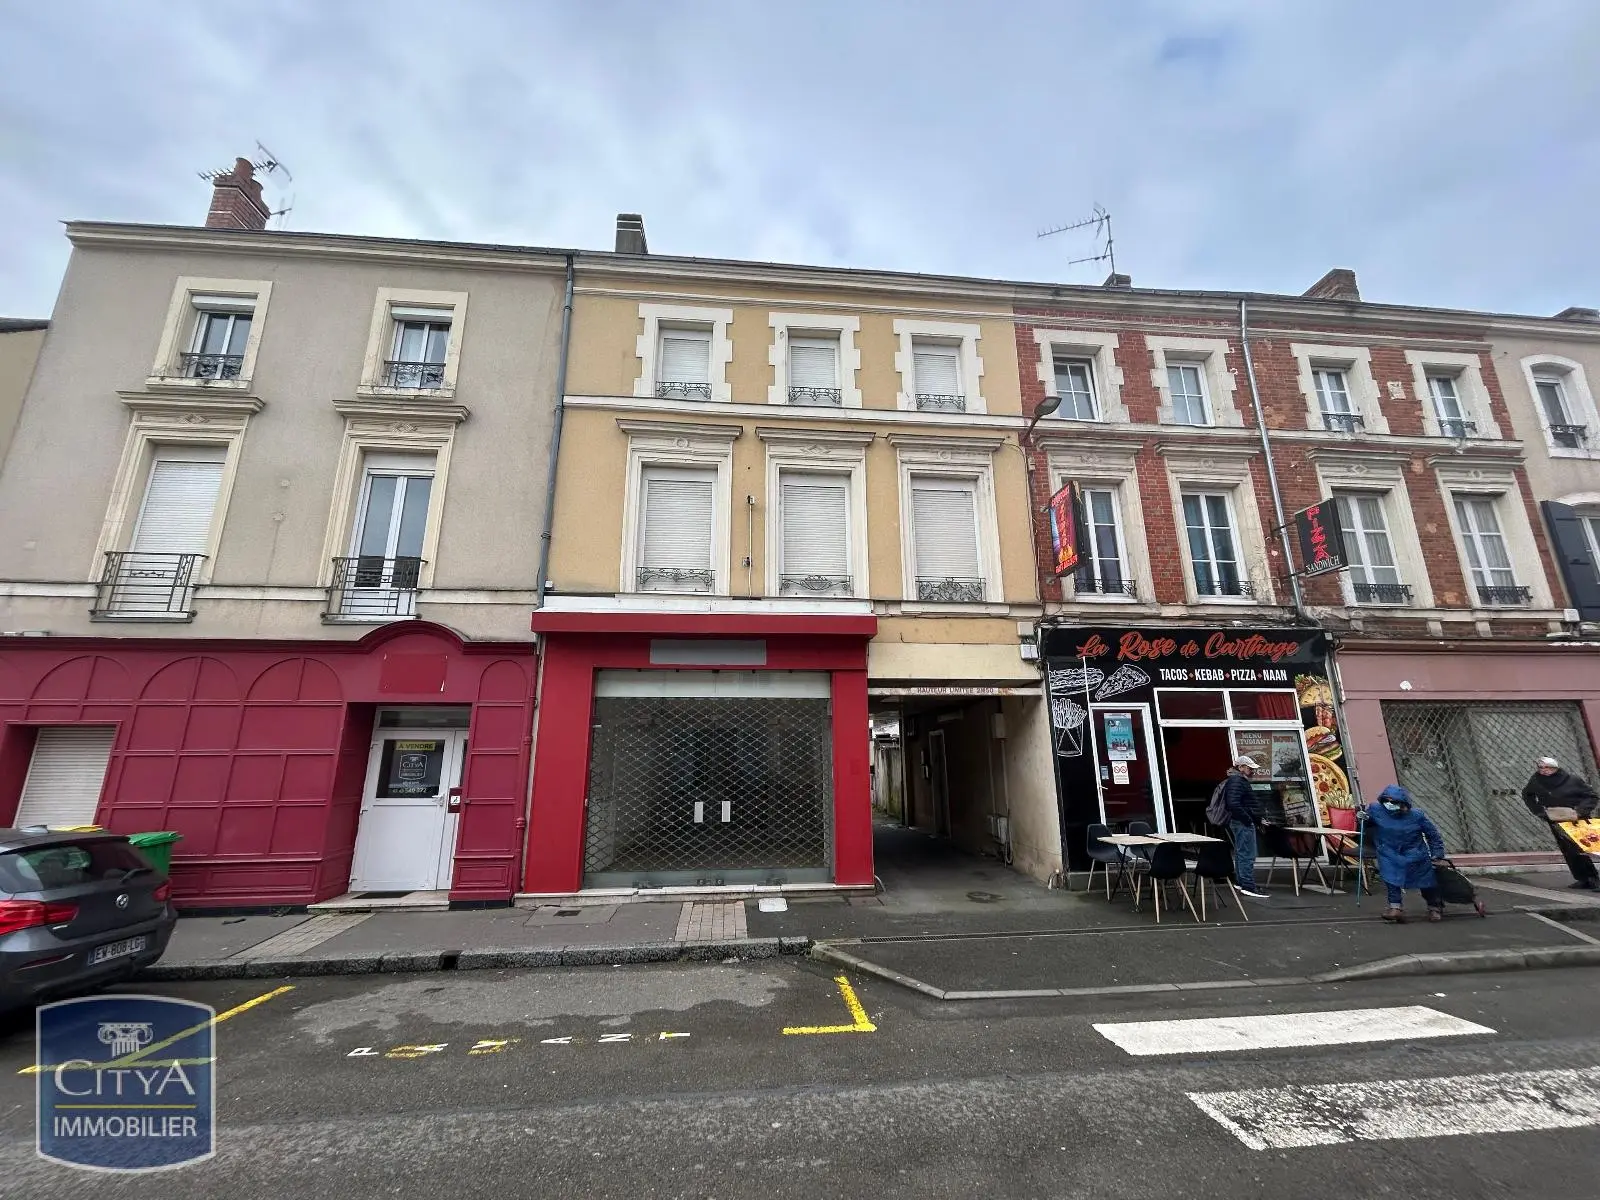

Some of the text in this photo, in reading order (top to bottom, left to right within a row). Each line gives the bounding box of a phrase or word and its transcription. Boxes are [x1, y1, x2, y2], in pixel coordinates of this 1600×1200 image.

[1306, 555, 1340, 574] SANDWICH
[1076, 631, 1299, 663] La Rose de Carthage
[1160, 669, 1288, 682] TACOS KEBAB PIZZA NAAN
